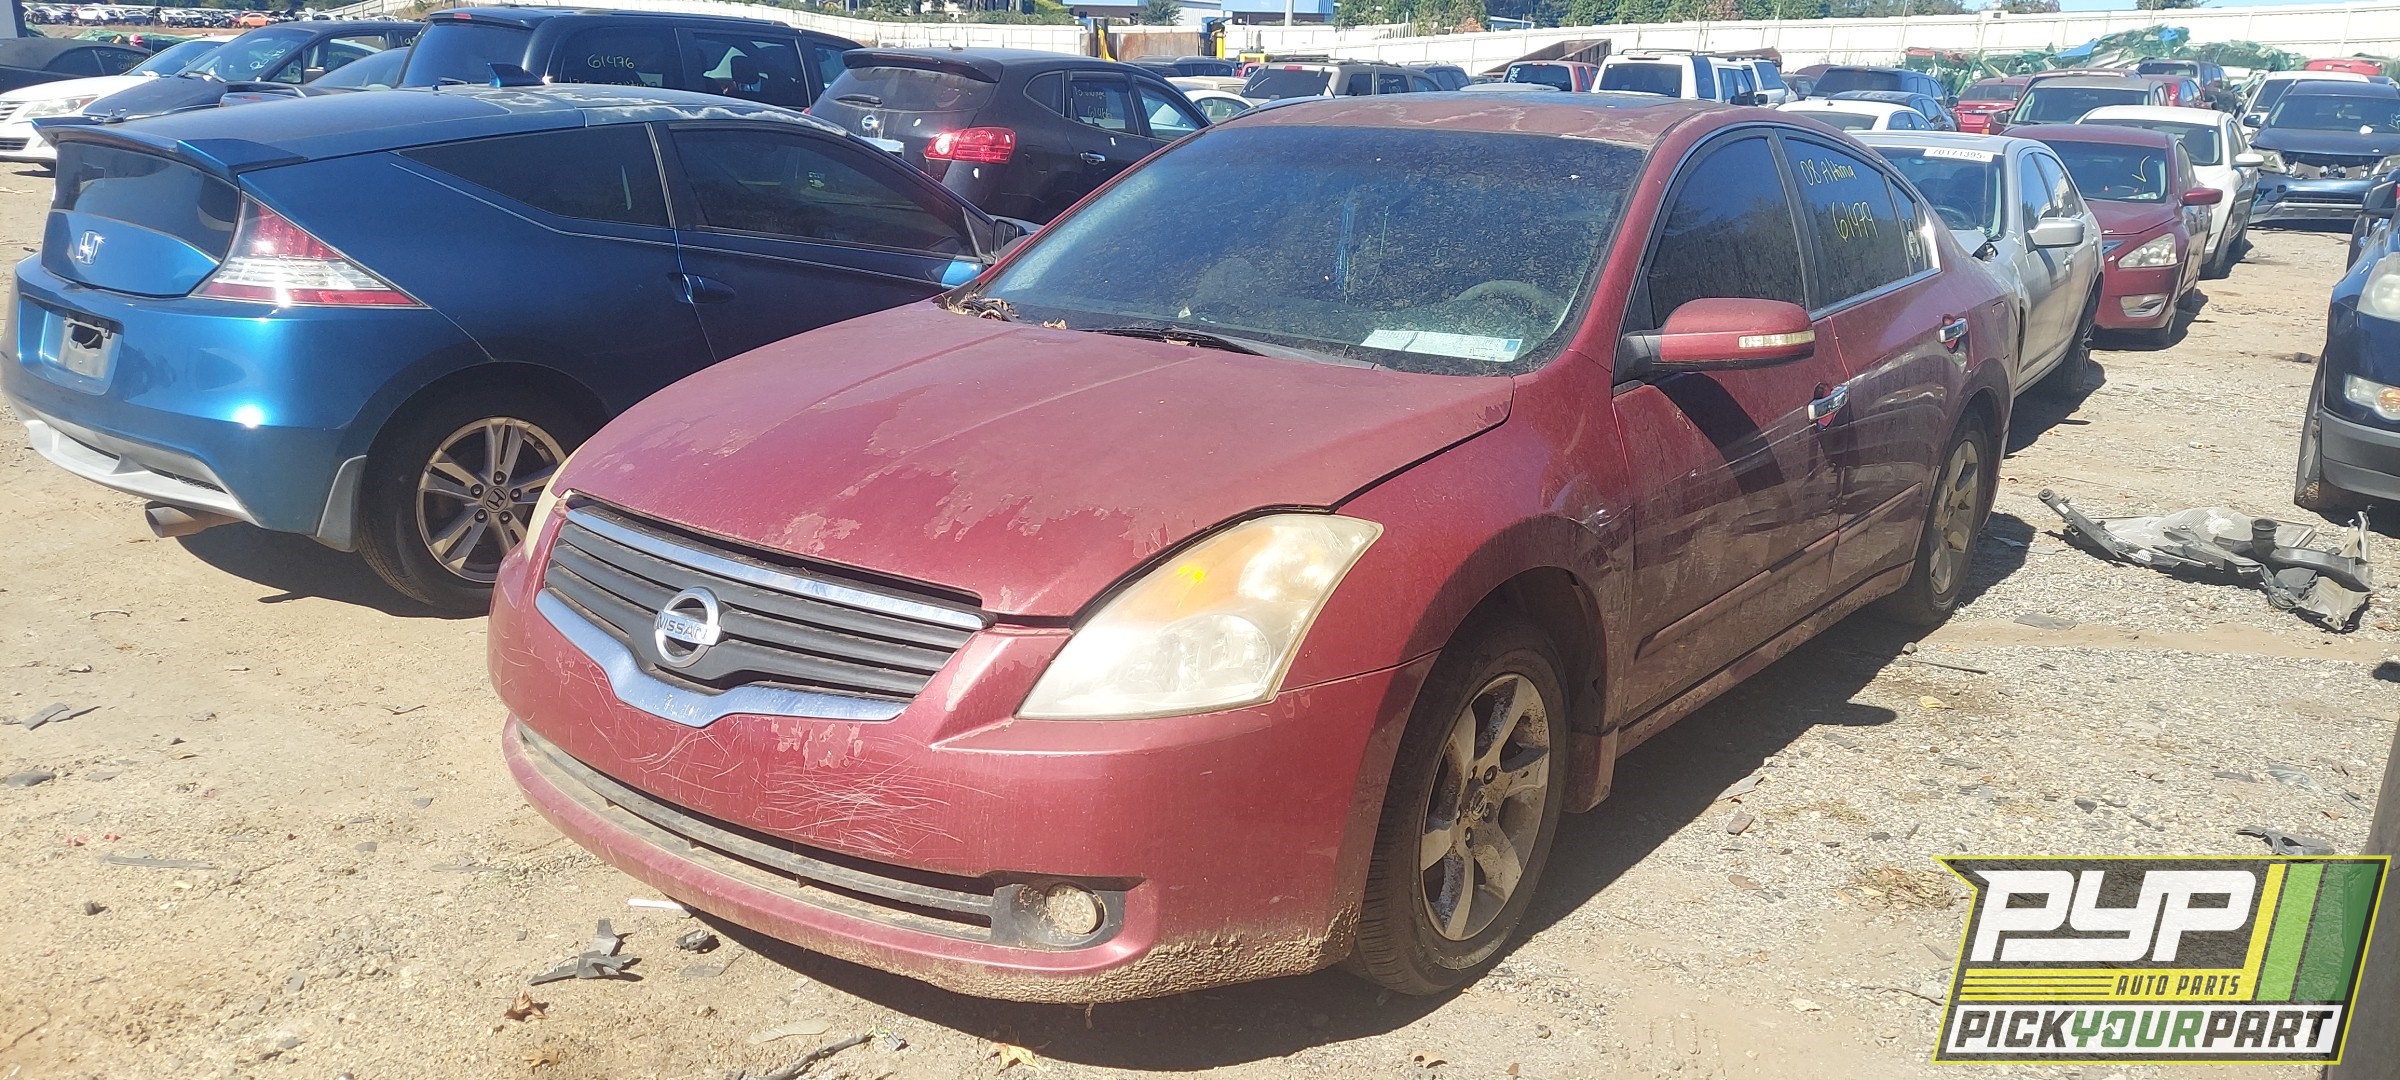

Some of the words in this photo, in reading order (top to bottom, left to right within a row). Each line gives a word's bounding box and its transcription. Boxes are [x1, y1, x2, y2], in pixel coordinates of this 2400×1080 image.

[587, 54, 635, 69] 61476
[1799, 158, 1822, 186] 08
[1820, 157, 1857, 185] Altima
[1831, 201, 1879, 242] 61499
[656, 613, 708, 640] NISSAN
